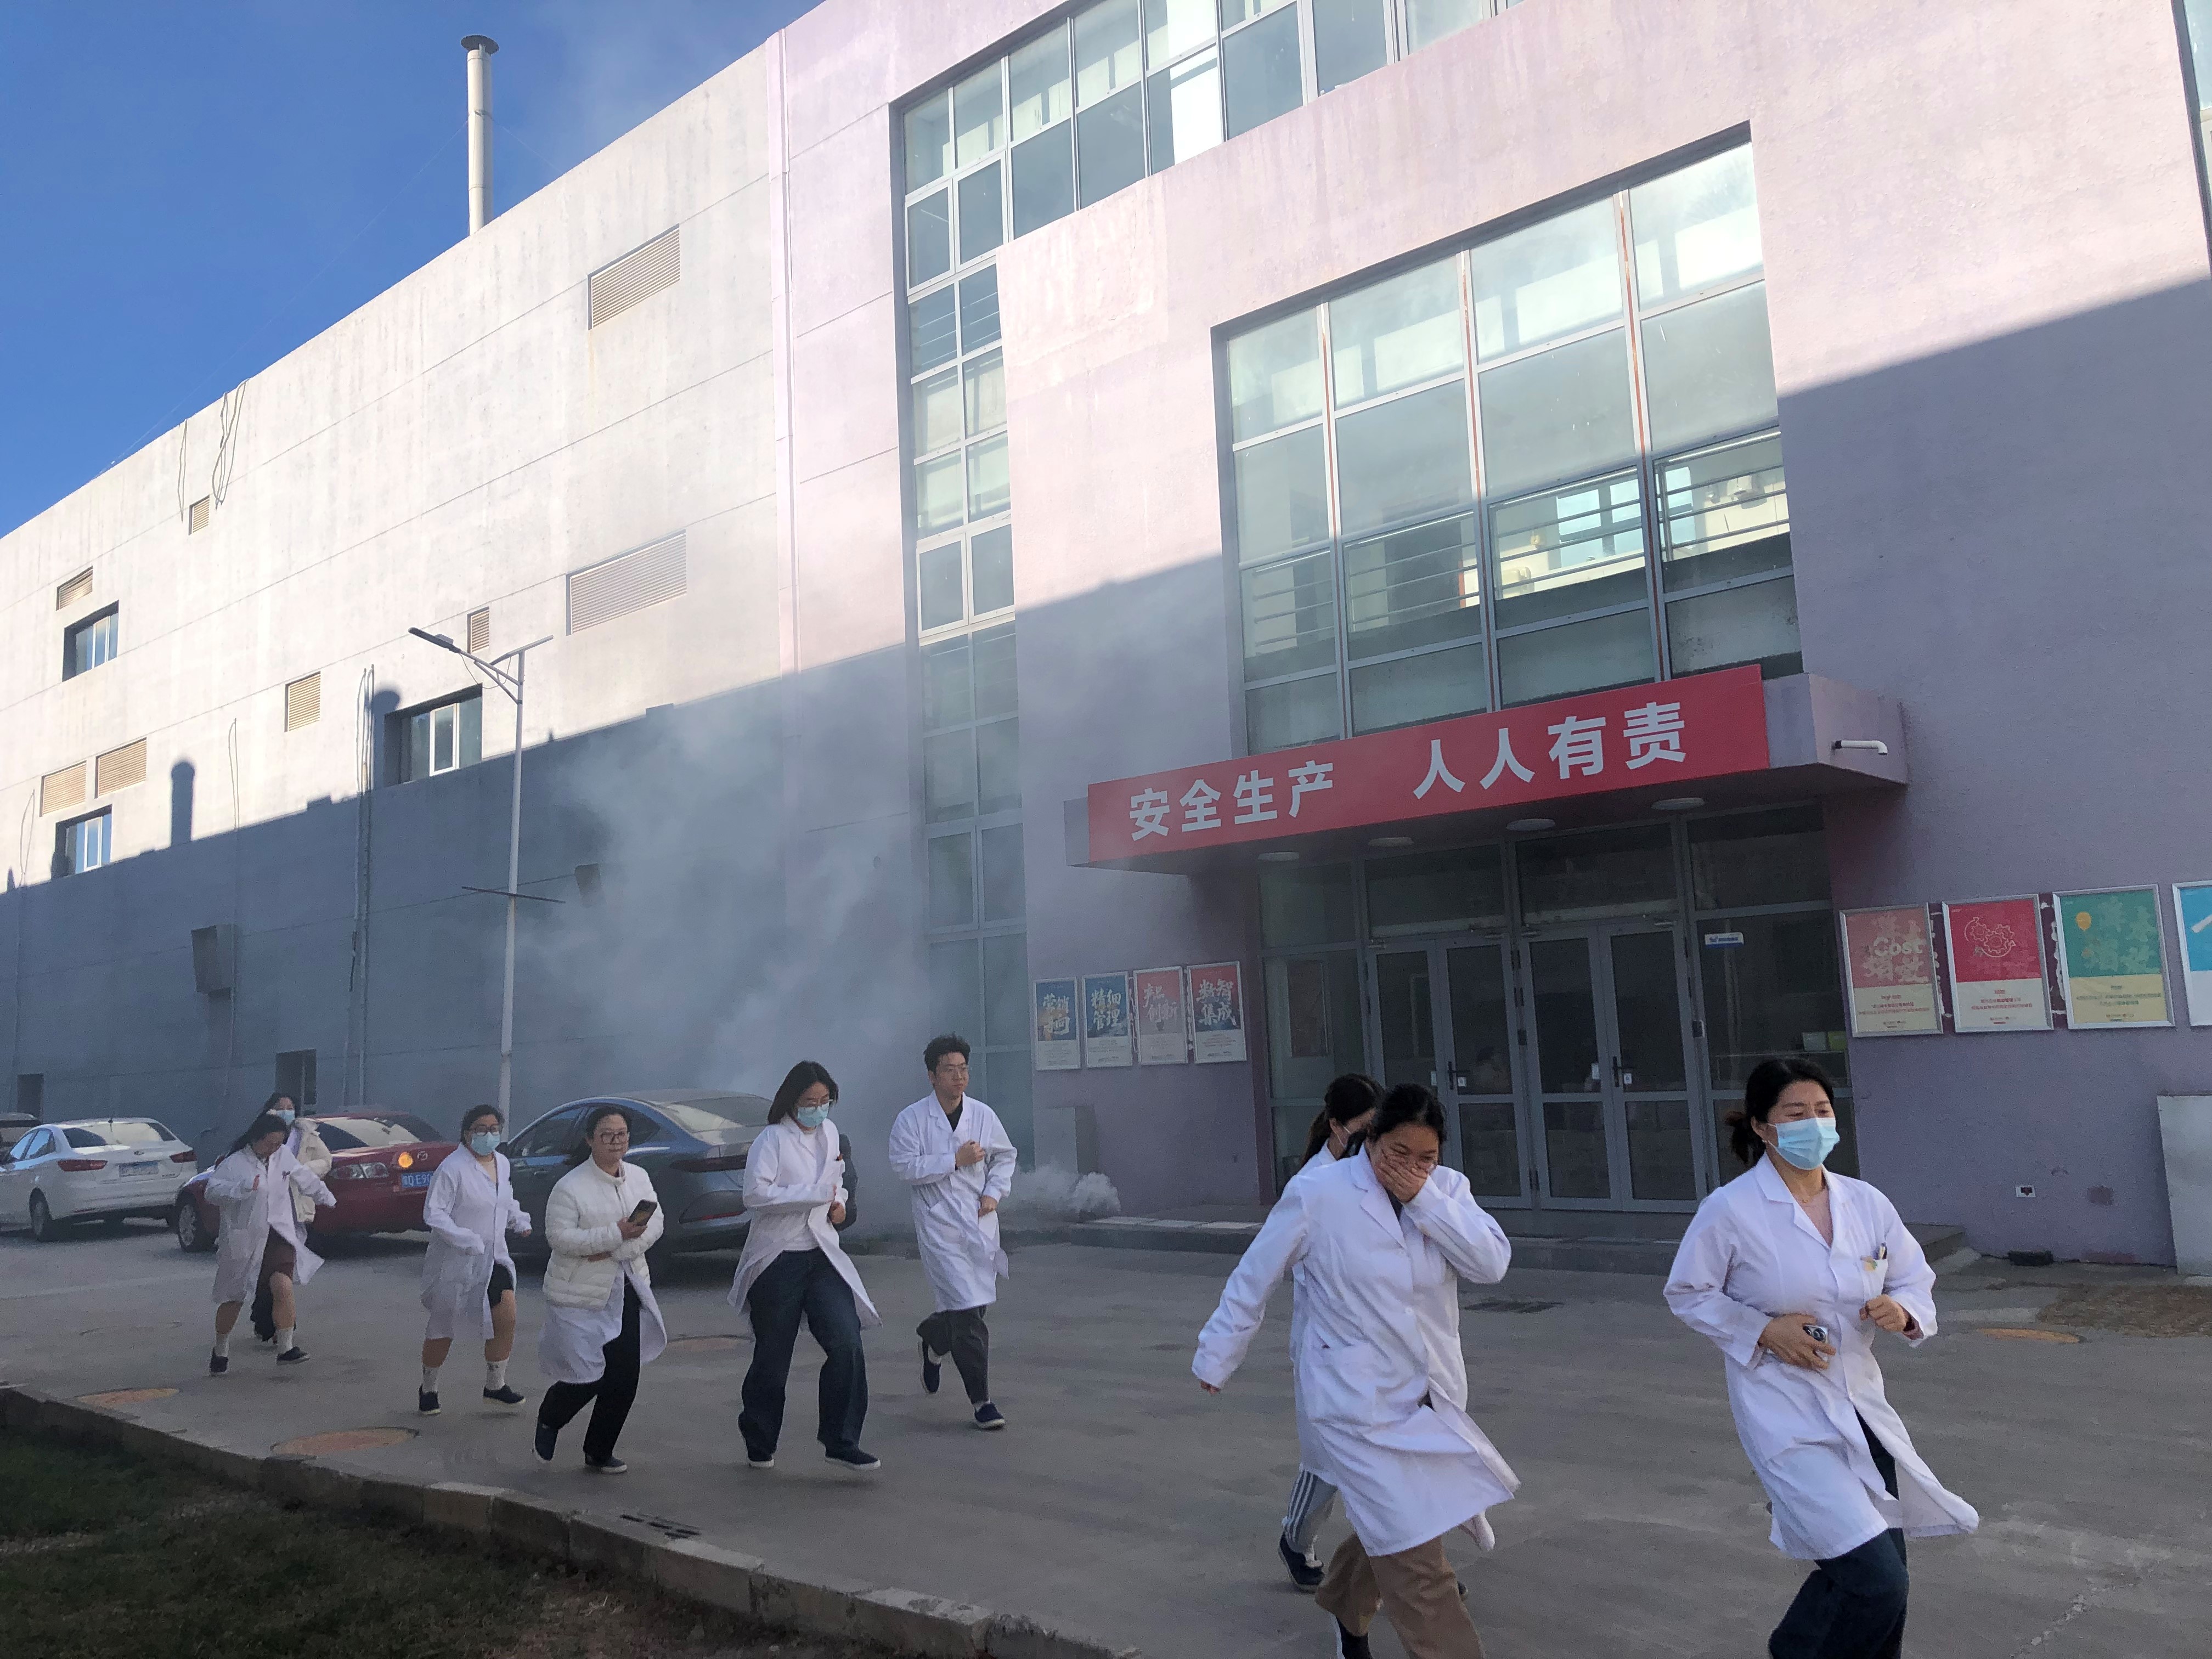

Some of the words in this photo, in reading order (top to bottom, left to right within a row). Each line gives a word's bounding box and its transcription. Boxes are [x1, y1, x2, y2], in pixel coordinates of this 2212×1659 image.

[1129, 760, 1334, 842] 安全生产
[1413, 702, 1686, 799] 人人有责
[1091, 988, 1122, 1009] 精细
[1093, 1009, 1121, 1031] 管理
[1198, 1001, 1237, 1026] 集成
